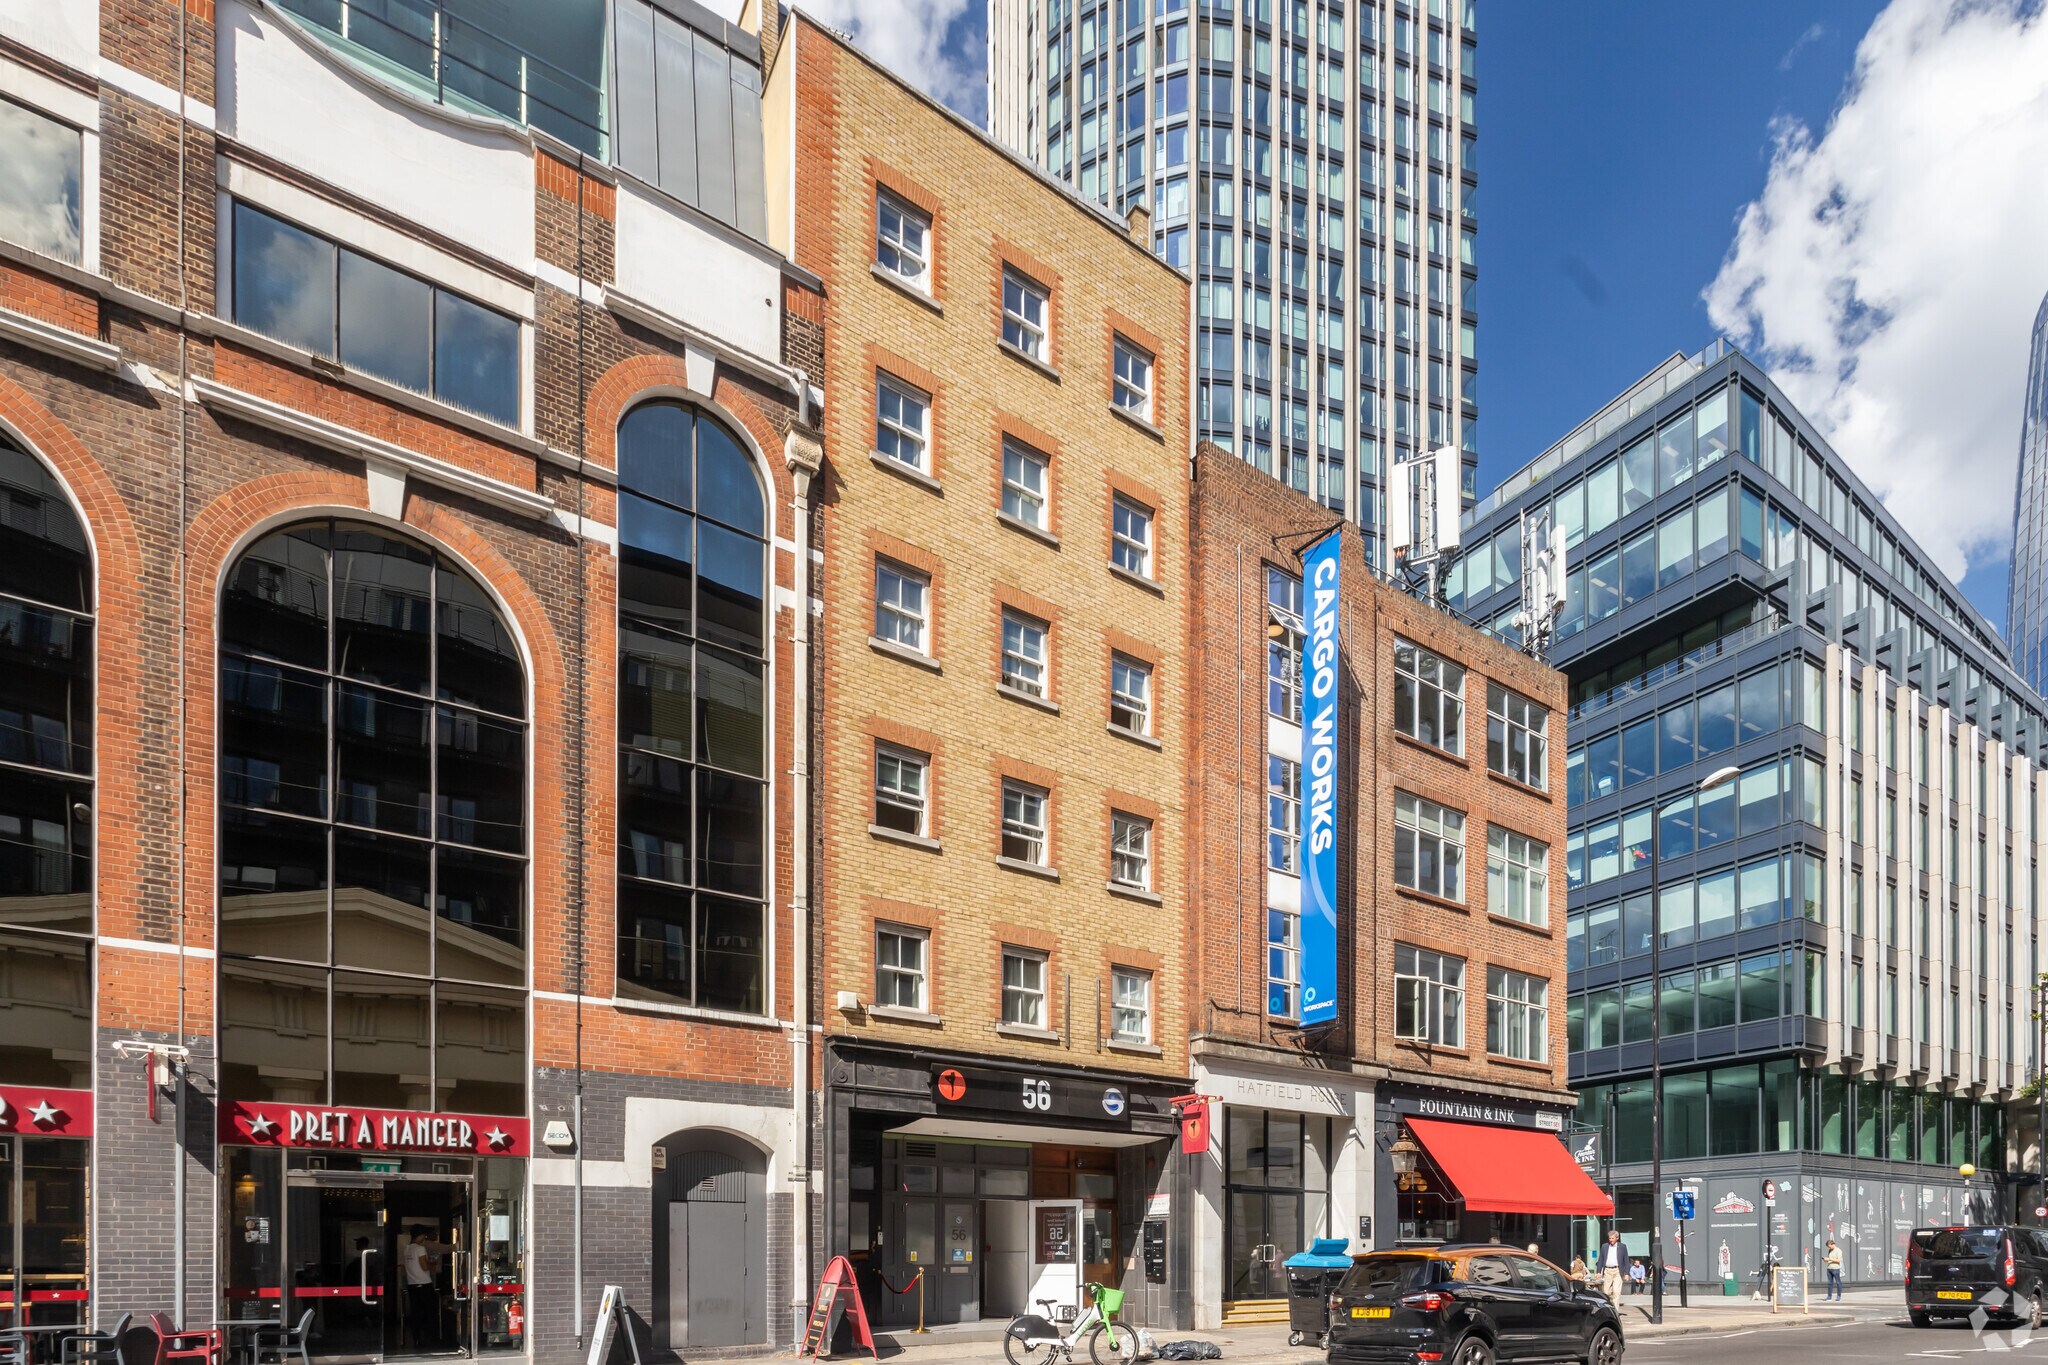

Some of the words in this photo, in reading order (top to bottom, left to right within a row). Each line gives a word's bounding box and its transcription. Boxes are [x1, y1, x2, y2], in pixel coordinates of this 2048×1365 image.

[1312, 557, 1337, 699] CARGO
[1311, 703, 1334, 855] WORKS
[1303, 1000, 1333, 1012] WORKSPACE
[1022, 1078, 1051, 1111] 56
[1237, 1080, 1302, 1100] HATFIELD
[1310, 1090, 1347, 1106] HOUSE
[1419, 1098, 1482, 1119] FOUNTAIN
[1484, 1107, 1493, 1120] &
[1494, 1108, 1516, 1123] INK
[290, 1109, 349, 1142] PRET
[357, 1115, 373, 1144] A
[382, 1115, 472, 1148] MANGER
[1581, 1154, 1596, 1163] INK
[951, 1228, 966, 1241] 56
